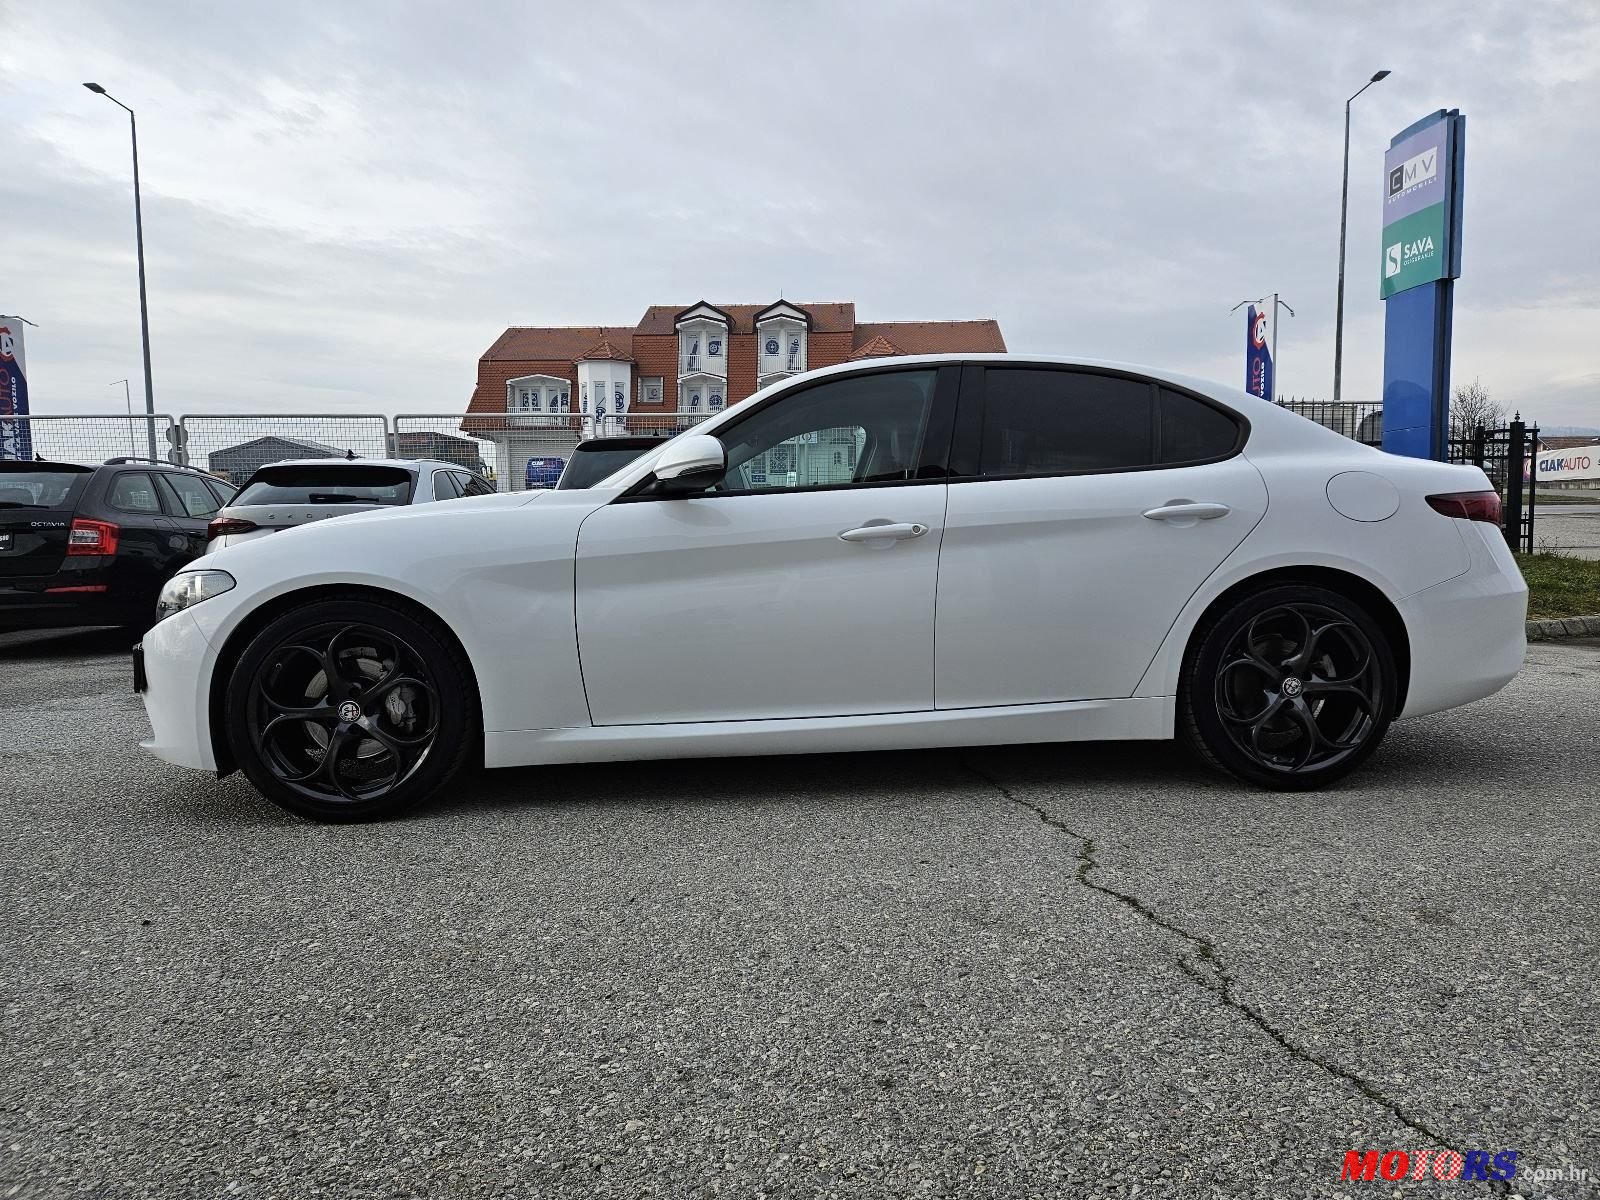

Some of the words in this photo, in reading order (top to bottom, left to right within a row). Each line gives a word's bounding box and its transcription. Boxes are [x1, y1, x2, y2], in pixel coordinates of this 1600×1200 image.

[1392, 154, 1434, 190] CMV
[1404, 235, 1434, 259] SAVA
[1540, 456, 1591, 472] CIAKAUTO
